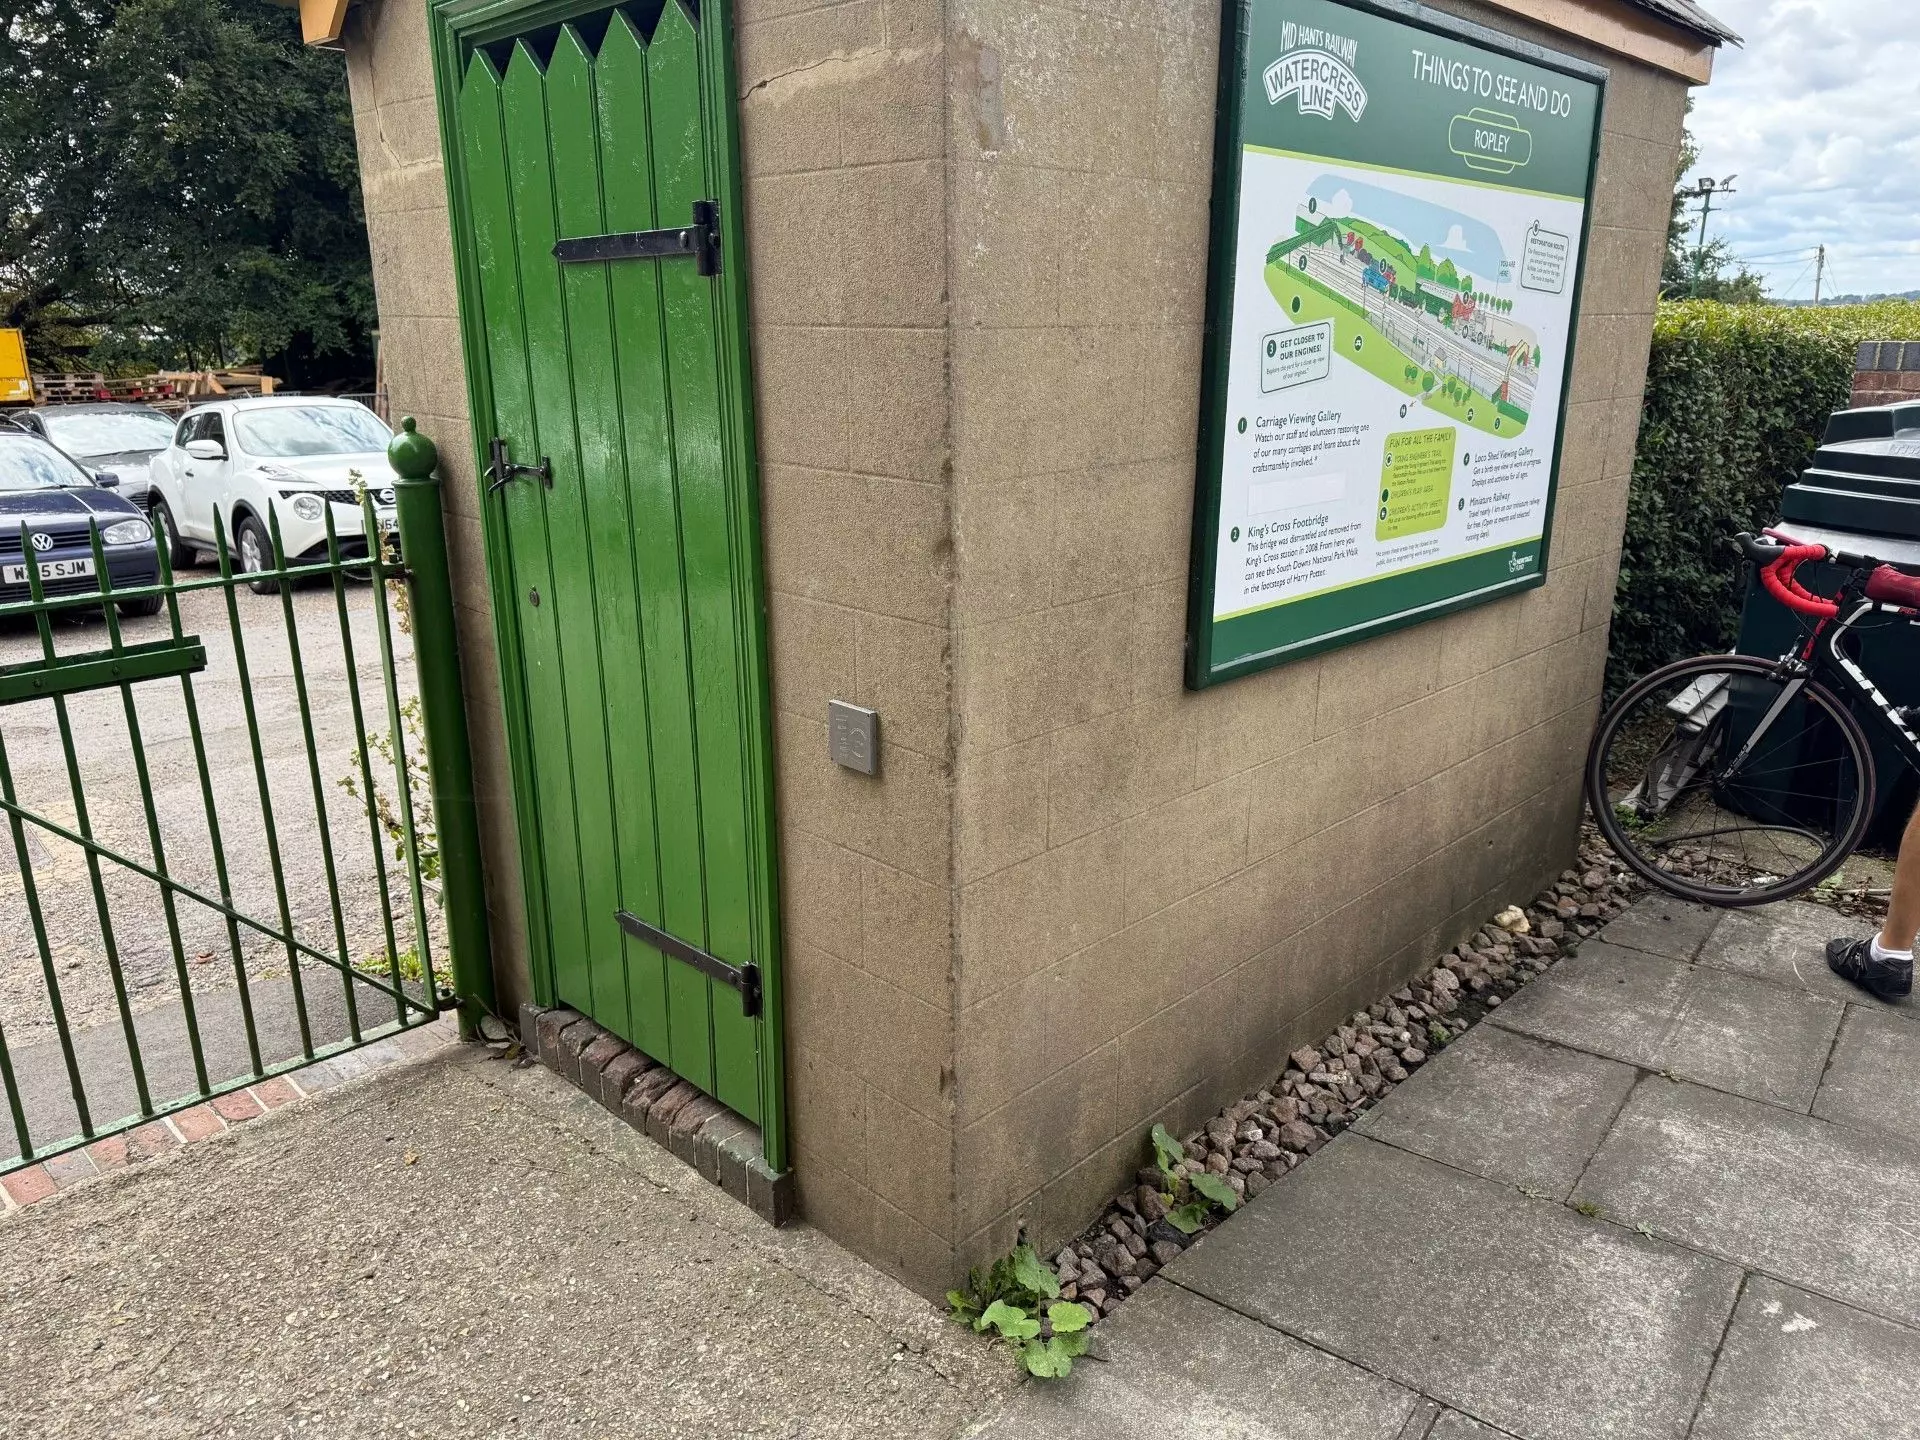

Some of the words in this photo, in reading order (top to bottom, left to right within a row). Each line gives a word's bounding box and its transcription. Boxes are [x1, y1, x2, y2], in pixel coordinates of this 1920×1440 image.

[1281, 20, 1297, 52] MID
[1298, 24, 1323, 47] HANTS
[1325, 32, 1358, 68] RAILWAY
[1269, 59, 1361, 111] WATERCRESS
[1412, 50, 1470, 91] THINGS
[1473, 67, 1492, 97] TO
[1495, 74, 1517, 104] SEE
[1517, 81, 1548, 112] AND
[1550, 90, 1571, 117] DO
[1302, 85, 1333, 110] LINE
[1474, 130, 1510, 153] ROPLEY
[1280, 339, 1292, 349] GET
[1293, 334, 1315, 345] CLOSER
[1317, 332, 1324, 340] TO
[1280, 351, 1293, 360] OUR
[1295, 344, 1322, 357] ENGINES!
[1256, 416, 1287, 429] Carriage
[1288, 413, 1316, 425] Viewing
[1318, 410, 1341, 423] Gallery
[1255, 432, 1273, 443] Watch
[1274, 433, 1284, 441] our
[1286, 429, 1297, 440] staff
[1299, 429, 1308, 439] and
[1309, 428, 1336, 437] volunteers
[1337, 424, 1359, 434] restoring
[1390, 438, 1399, 448] FUN
[1401, 437, 1411, 446] FOR
[1412, 435, 1421, 444] ALL
[1424, 434, 1432, 443] THE
[1434, 432, 1451, 442] FAMILY
[1254, 448, 1261, 458] of
[1261, 450, 1271, 458] our
[1272, 448, 1287, 457] many
[1288, 444, 1311, 454] carriages
[1313, 441, 1322, 450] and
[1323, 440, 1336, 449] learn
[1337, 438, 1351, 447] about
[1352, 437, 1360, 445] the
[1474, 453, 1486, 463] Loco
[1487, 451, 1498, 461] Shed
[1499, 449, 1517, 460] Viewing
[1518, 446, 1534, 456] Gallery
[1252, 460, 1289, 473] craftsmanship
[1469, 496, 1492, 506] Miniature
[1493, 492, 1510, 502] Railway
[1248, 524, 1269, 538] King's
[1271, 521, 1291, 533] Cross
[1292, 514, 1329, 527] Footbridge
[1247, 542, 1258, 552] This
[1260, 539, 1277, 550] bridge
[1289, 533, 1317, 544] dismantled
[1318, 530, 1327, 538] and
[1328, 524, 1349, 535] removed
[1350, 523, 1361, 531] from
[1245, 556, 1262, 567] King's
[1263, 553, 1279, 563] Cross
[1280, 549, 1298, 560] station
[1299, 547, 1304, 555] in
[1319, 541, 1333, 550] From
[1334, 538, 1344, 547] here
[1345, 537, 1355, 547] you
[55, 560, 86, 576] SJM
[1245, 572, 1255, 581] can
[1256, 570, 1265, 578] see
[1266, 567, 1275, 576] the
[1276, 563, 1292, 574] South
[1293, 559, 1311, 570] Downs
[1312, 553, 1333, 564] National
[1333, 550, 1345, 560] Park
[1244, 586, 1249, 595] in
[1250, 583, 1260, 593] the
[1261, 579, 1286, 591] footsteps
[1287, 575, 1293, 585] of
[1293, 572, 1308, 583] Harry
